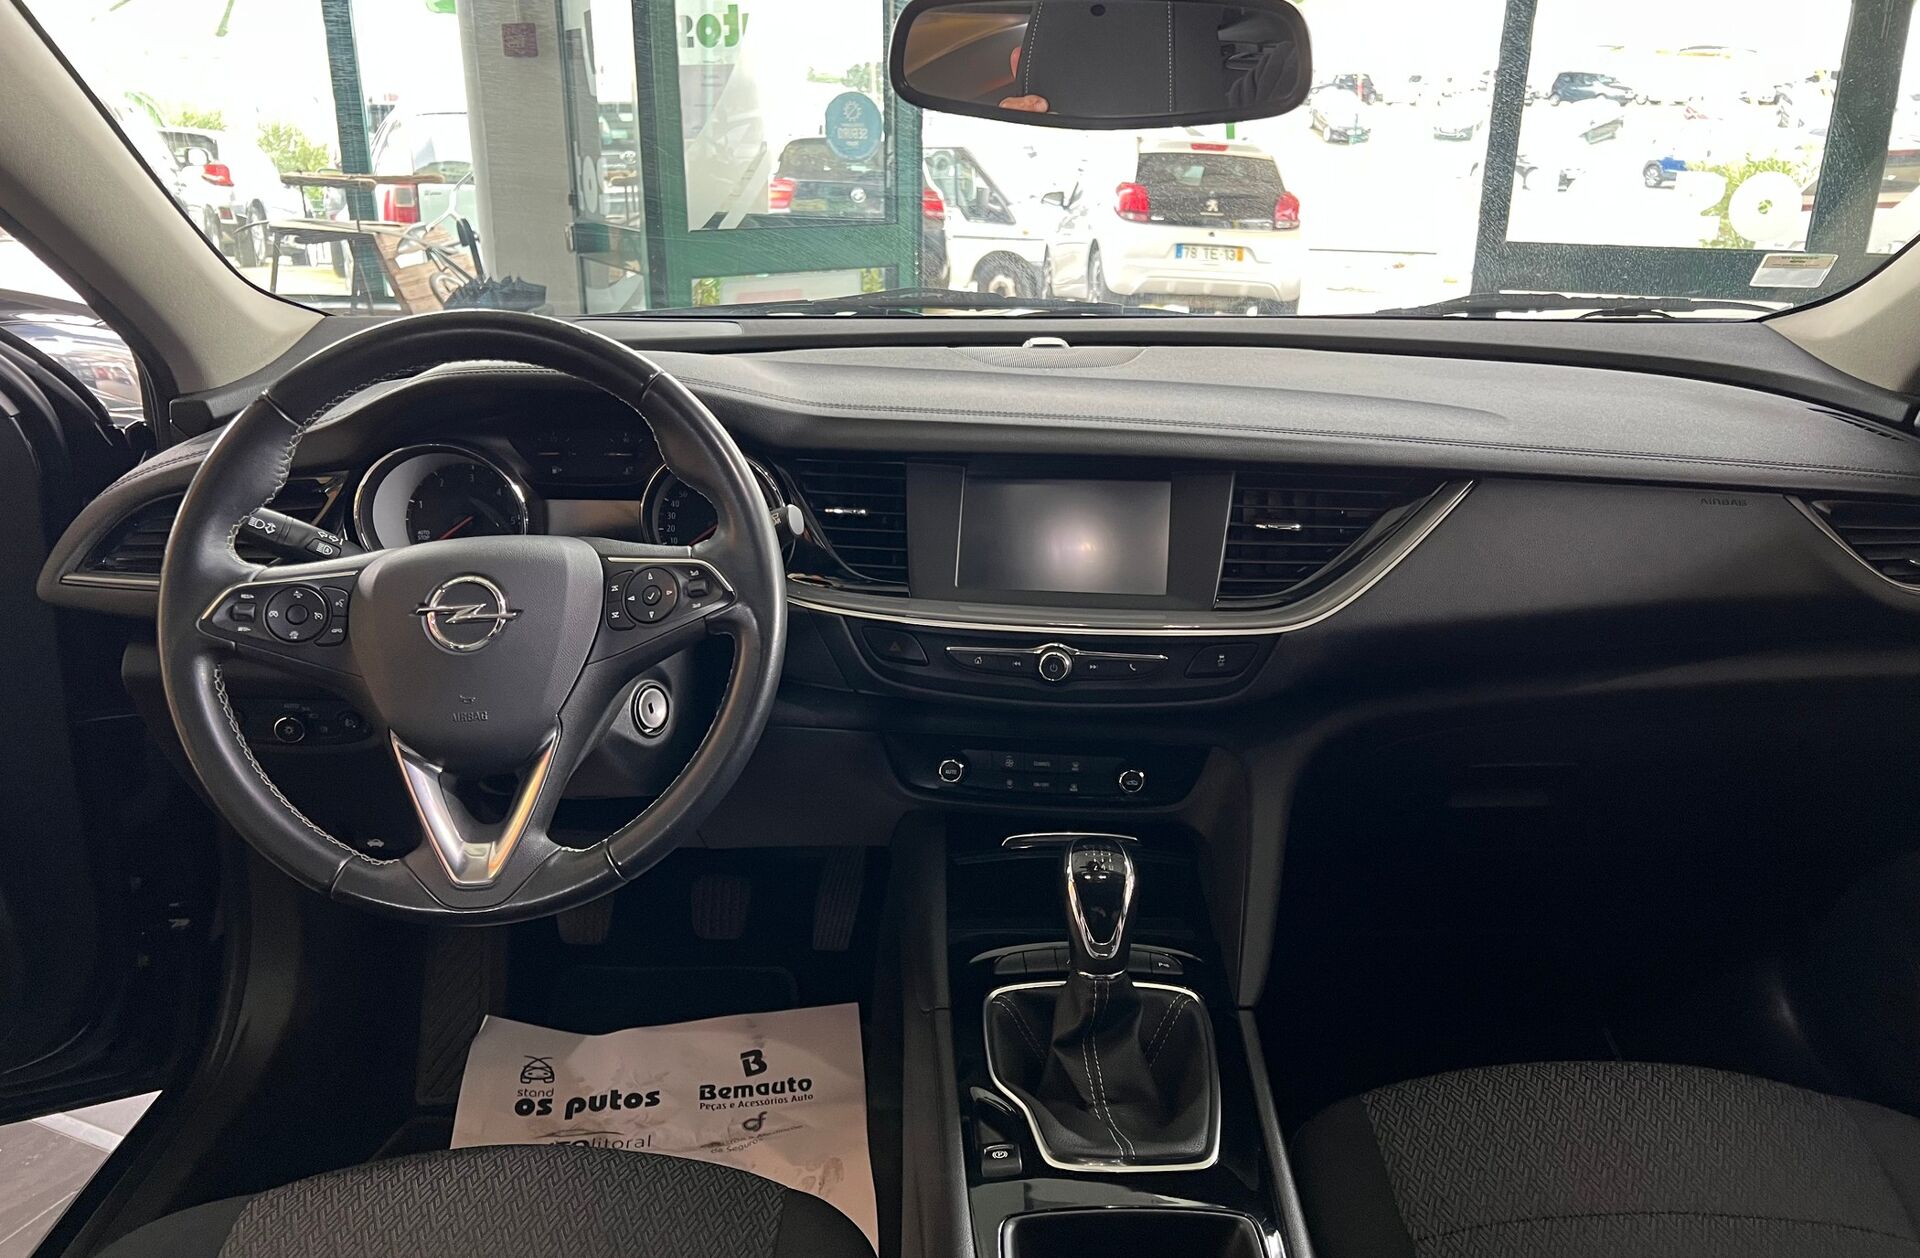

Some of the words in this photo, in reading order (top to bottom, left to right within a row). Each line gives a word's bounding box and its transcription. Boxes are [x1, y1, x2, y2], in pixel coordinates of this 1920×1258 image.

[666, 511, 677, 520] 30
[666, 525, 676, 533] 20
[740, 1049, 768, 1078] B
[517, 1088, 554, 1098] stand
[699, 1077, 812, 1101] Bemauto
[514, 1098, 553, 1117] os
[564, 1090, 661, 1121] putos
[700, 1102, 727, 1112] Peças
[738, 1097, 789, 1109] Acessórios
[791, 1094, 814, 1104] Auto
